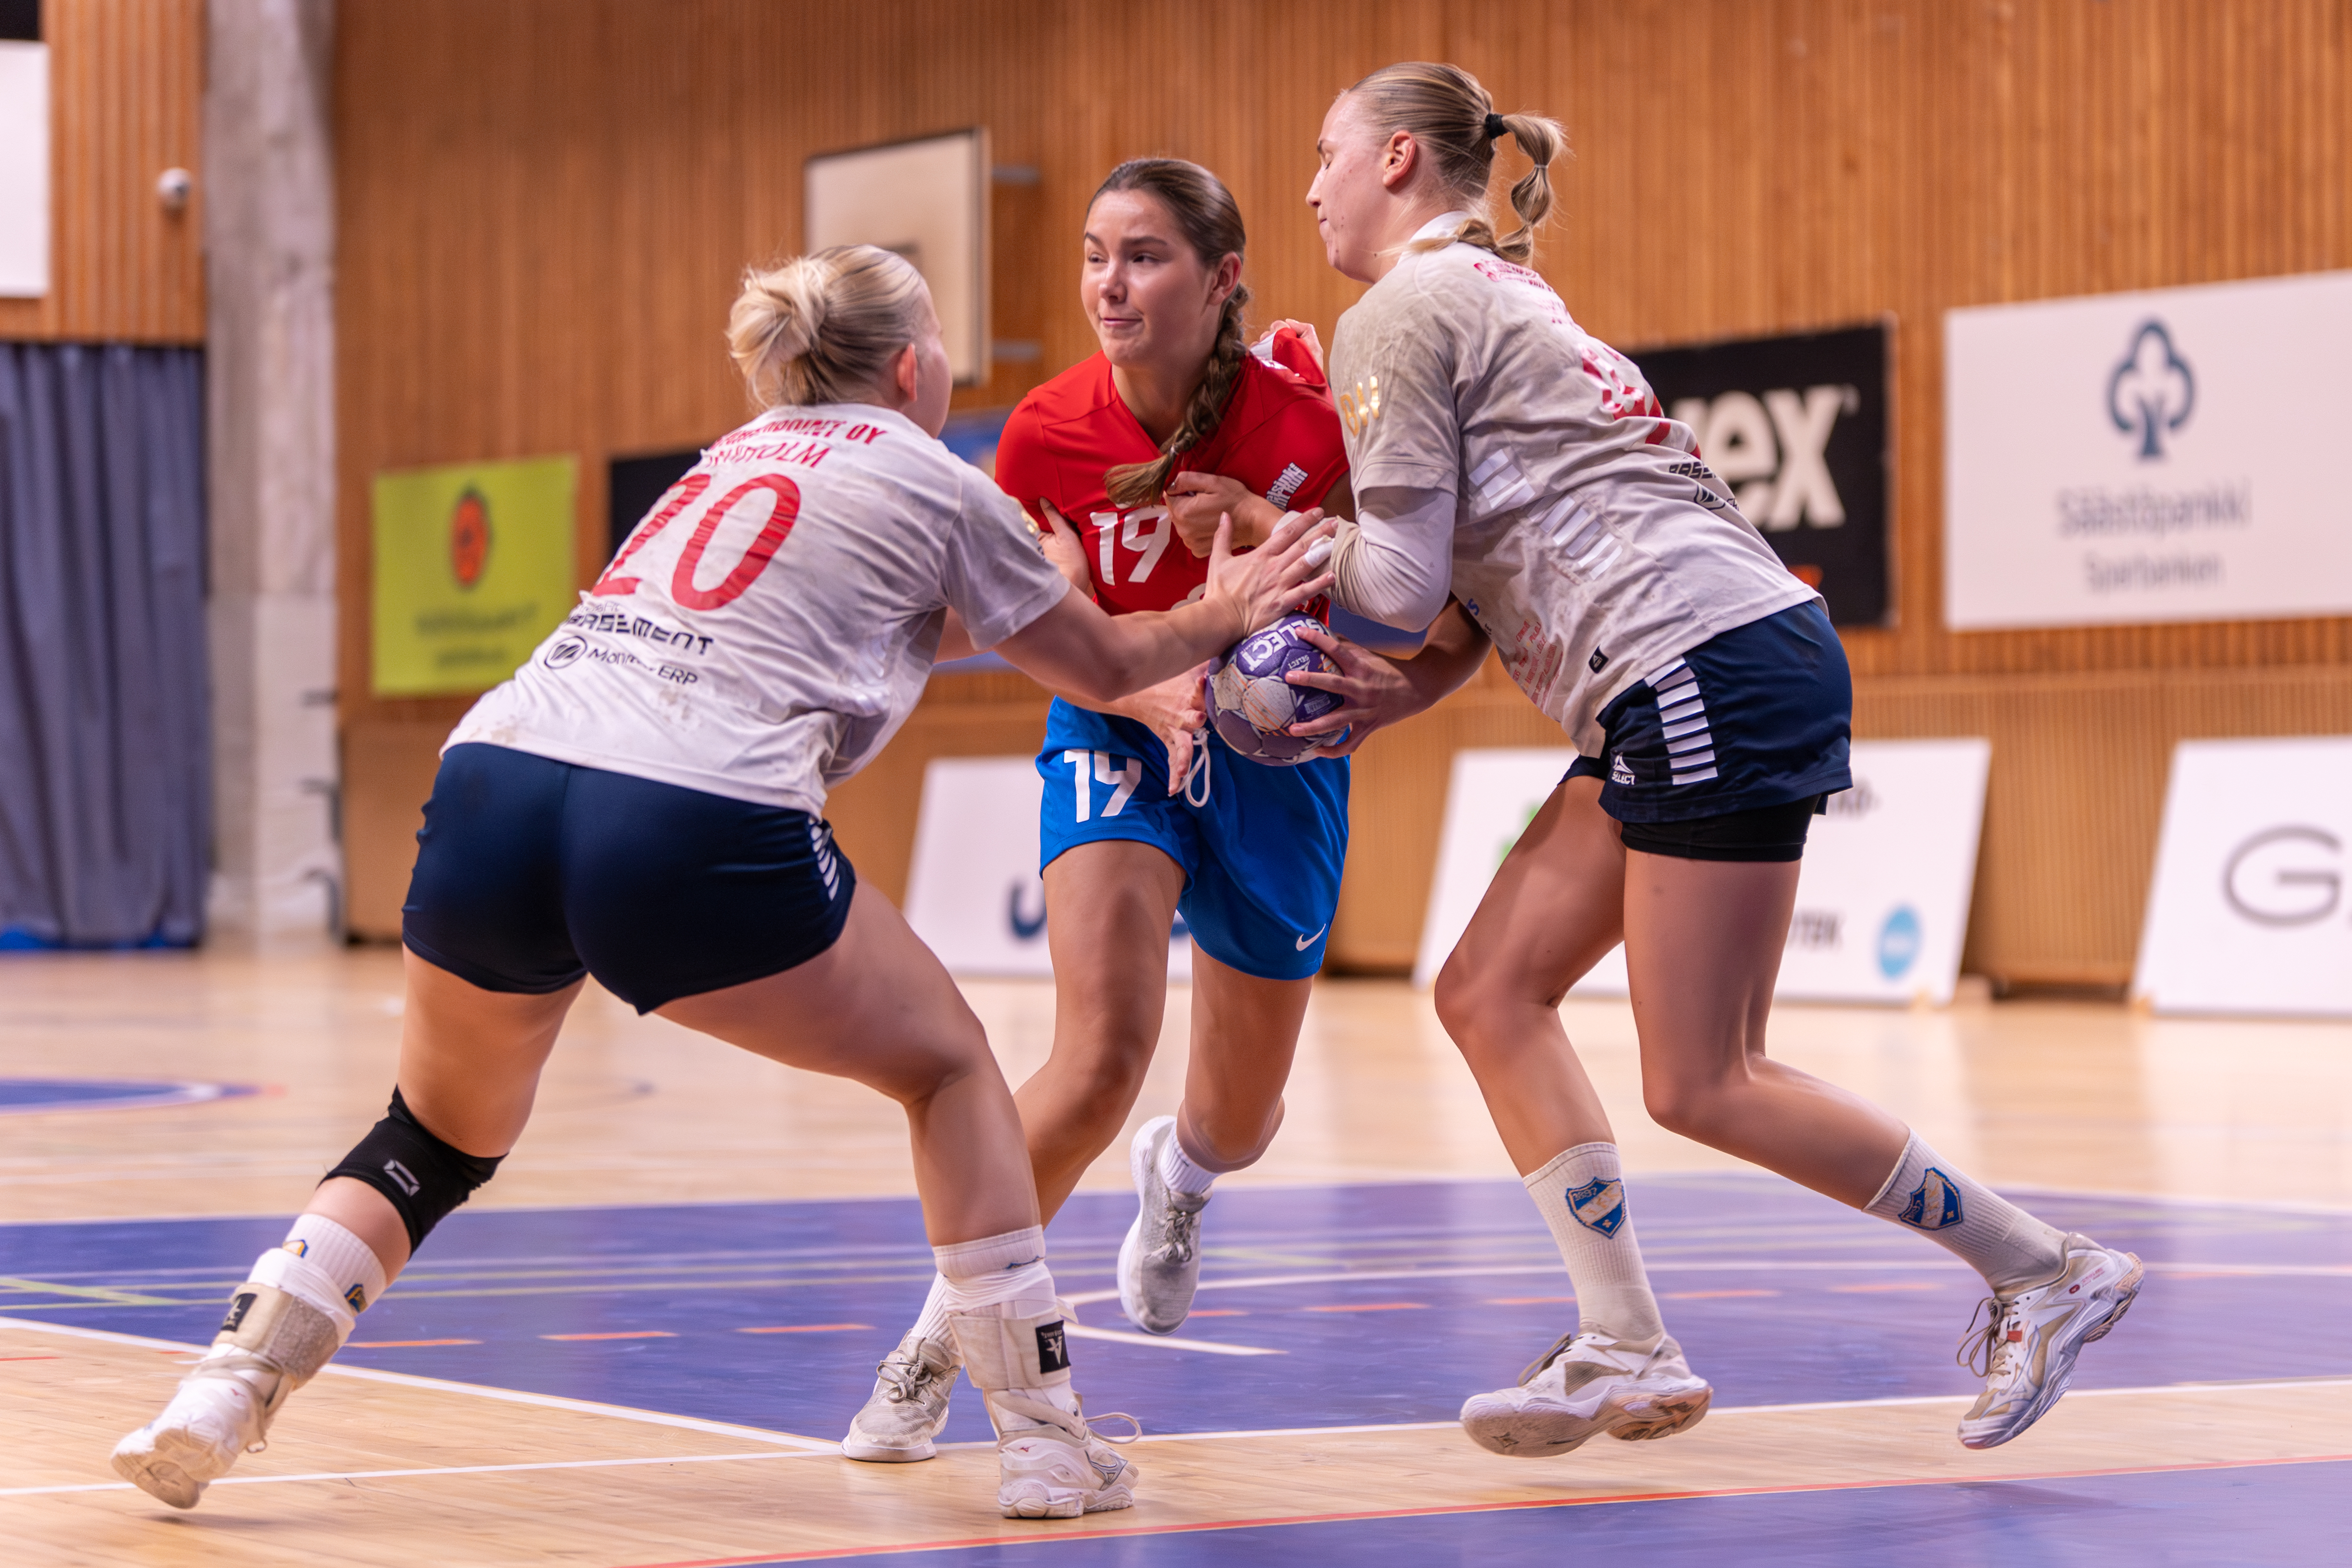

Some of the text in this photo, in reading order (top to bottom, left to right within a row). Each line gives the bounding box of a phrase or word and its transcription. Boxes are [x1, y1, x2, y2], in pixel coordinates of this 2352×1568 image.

[592, 473, 800, 610] 20
[1090, 505, 1172, 586] 19
[658, 665, 698, 684] ERP
[1288, 655, 1310, 669] SELECT
[1064, 749, 1142, 824] 19
[1611, 771, 1635, 785] SELECT
